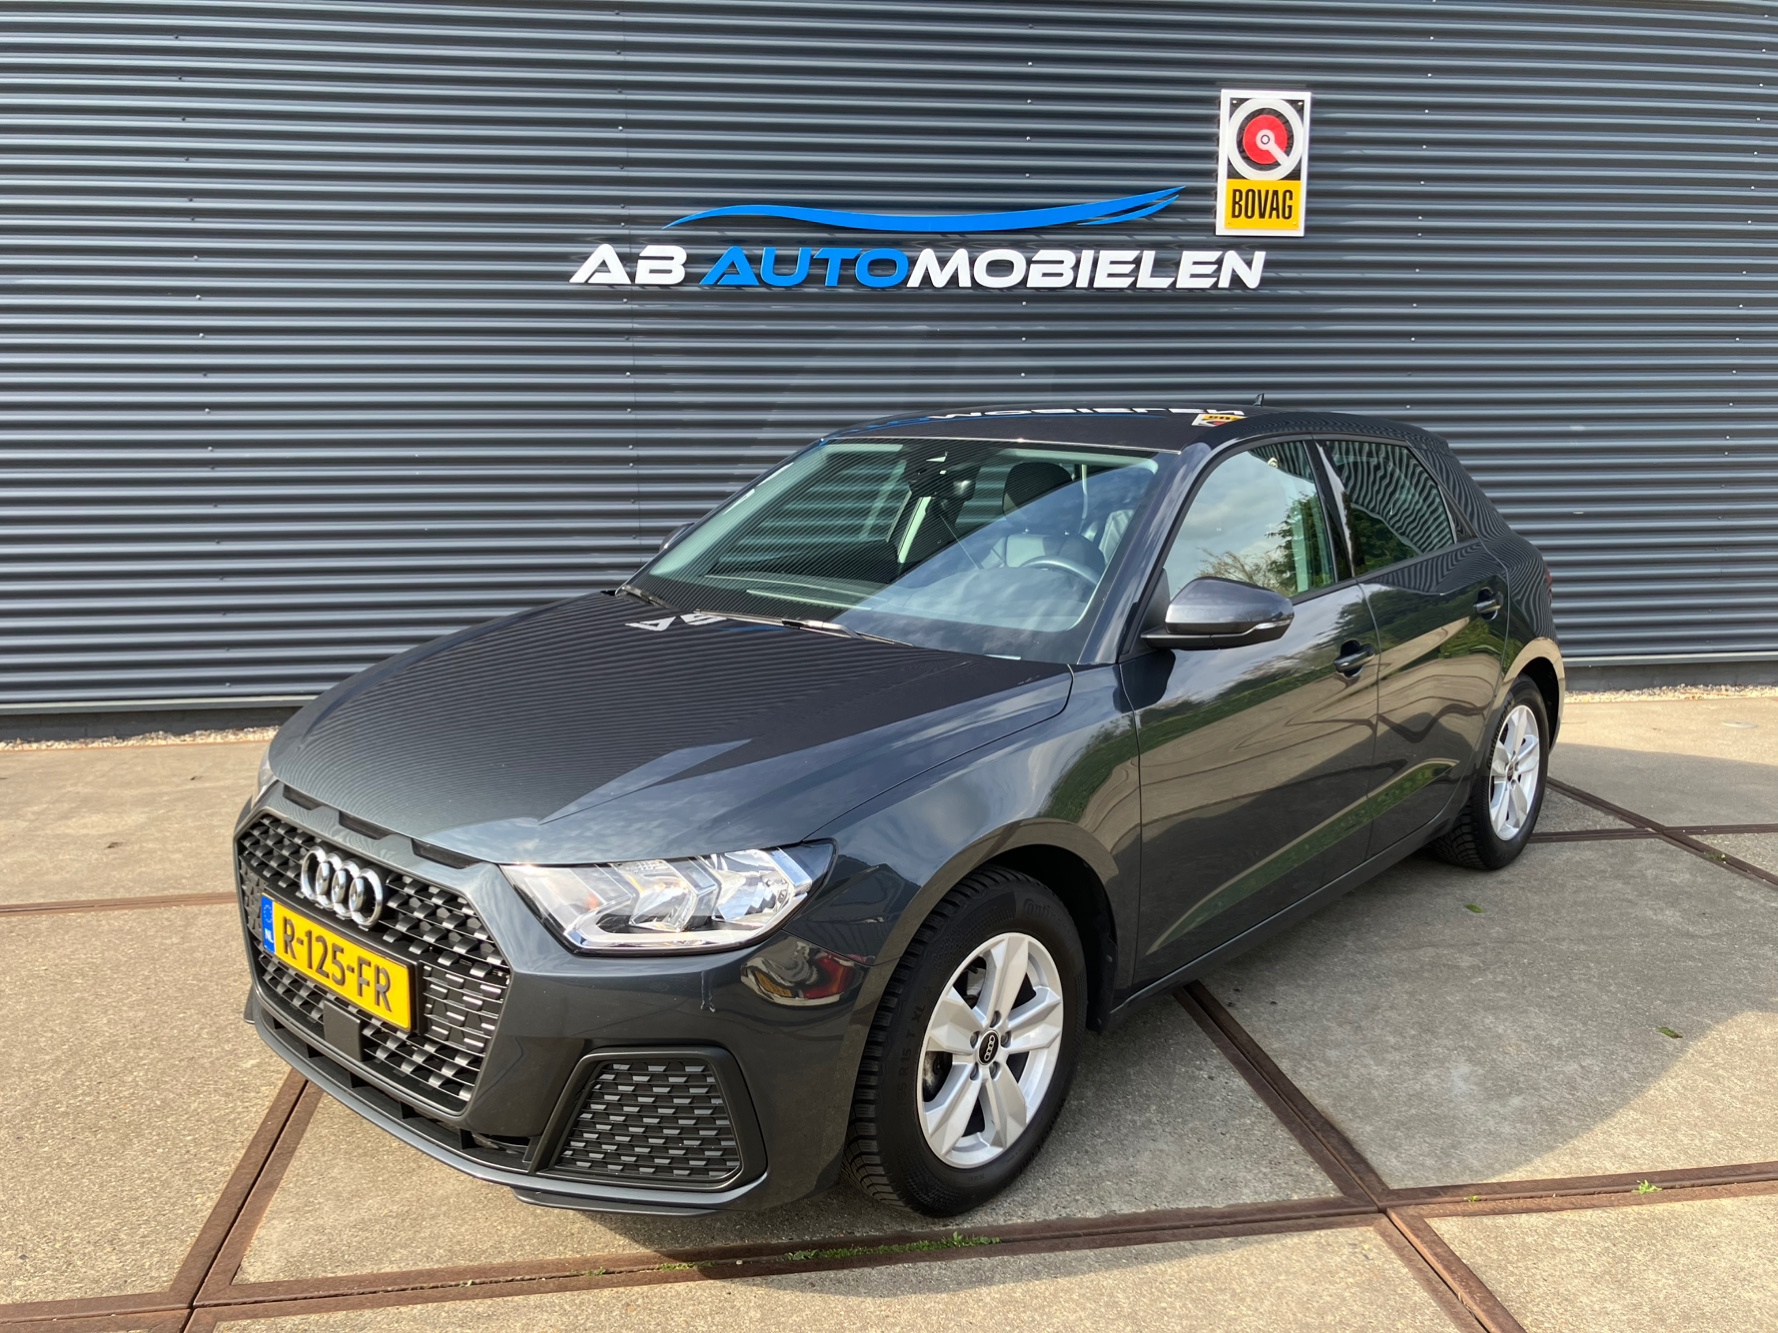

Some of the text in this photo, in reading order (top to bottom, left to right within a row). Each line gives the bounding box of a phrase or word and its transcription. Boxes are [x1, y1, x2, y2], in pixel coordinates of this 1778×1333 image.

[1231, 188, 1294, 220] BOVAG
[569, 243, 1266, 289] AB AUTOMOBIELEN
[264, 928, 274, 944] NL
[283, 915, 392, 1013] R-125-FR
